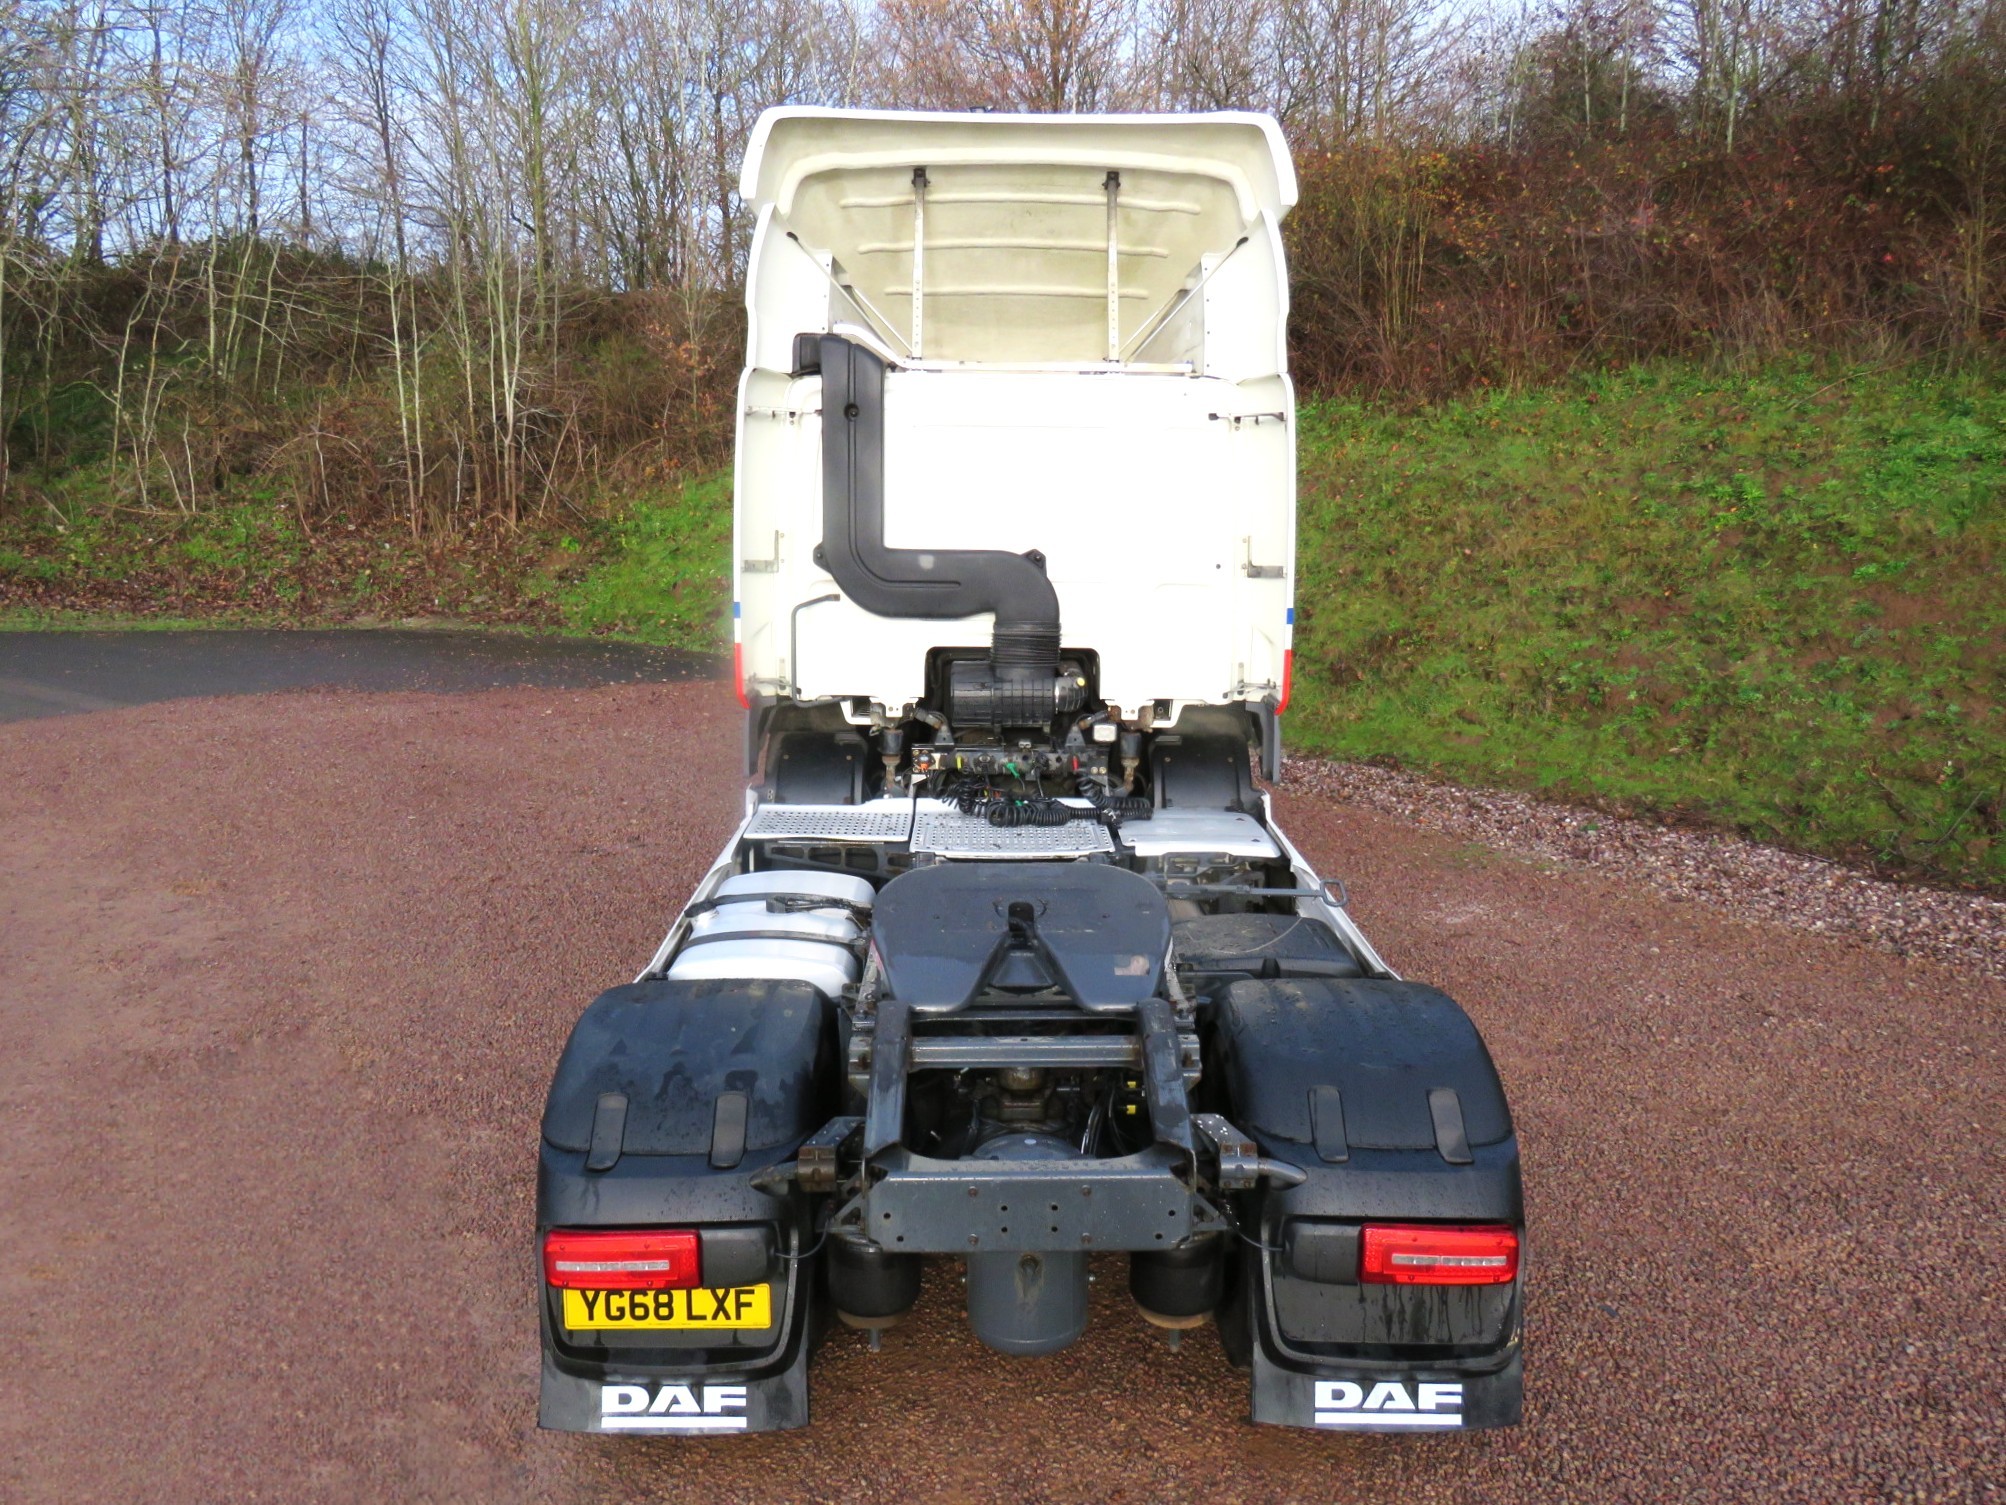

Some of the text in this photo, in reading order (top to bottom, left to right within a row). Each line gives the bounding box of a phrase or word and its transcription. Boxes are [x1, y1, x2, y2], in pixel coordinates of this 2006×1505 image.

[579, 1288, 755, 1321] YG68 LXF
[601, 1386, 747, 1413] DAF
[1314, 1381, 1462, 1410] DAF
